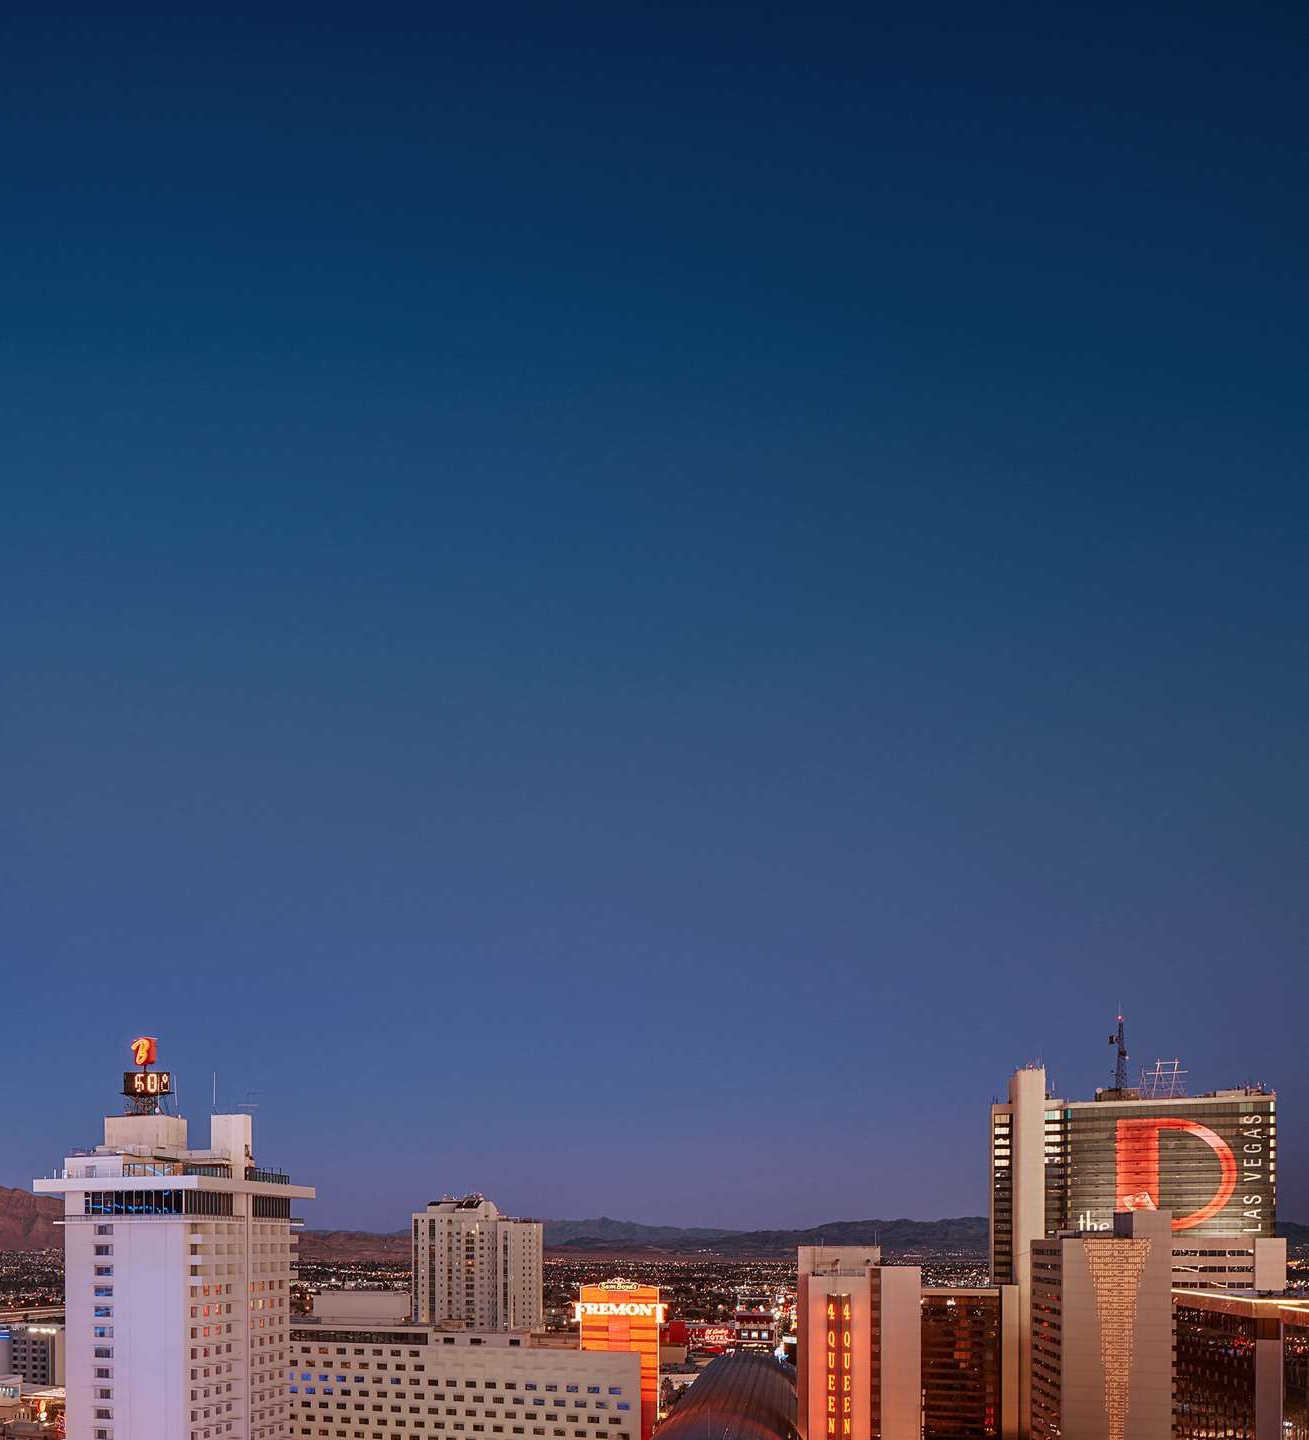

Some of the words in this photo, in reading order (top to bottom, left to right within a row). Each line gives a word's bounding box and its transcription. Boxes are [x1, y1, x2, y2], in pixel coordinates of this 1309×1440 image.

[1243, 1114, 1262, 1182] VEGAS
[1077, 1210, 1111, 1231] the
[1116, 1118, 1237, 1231] D
[1243, 1194, 1262, 1232] LAS
[571, 1302, 668, 1324] FREMONT
[827, 1303, 835, 1320] 4
[843, 1303, 851, 1320] 4
